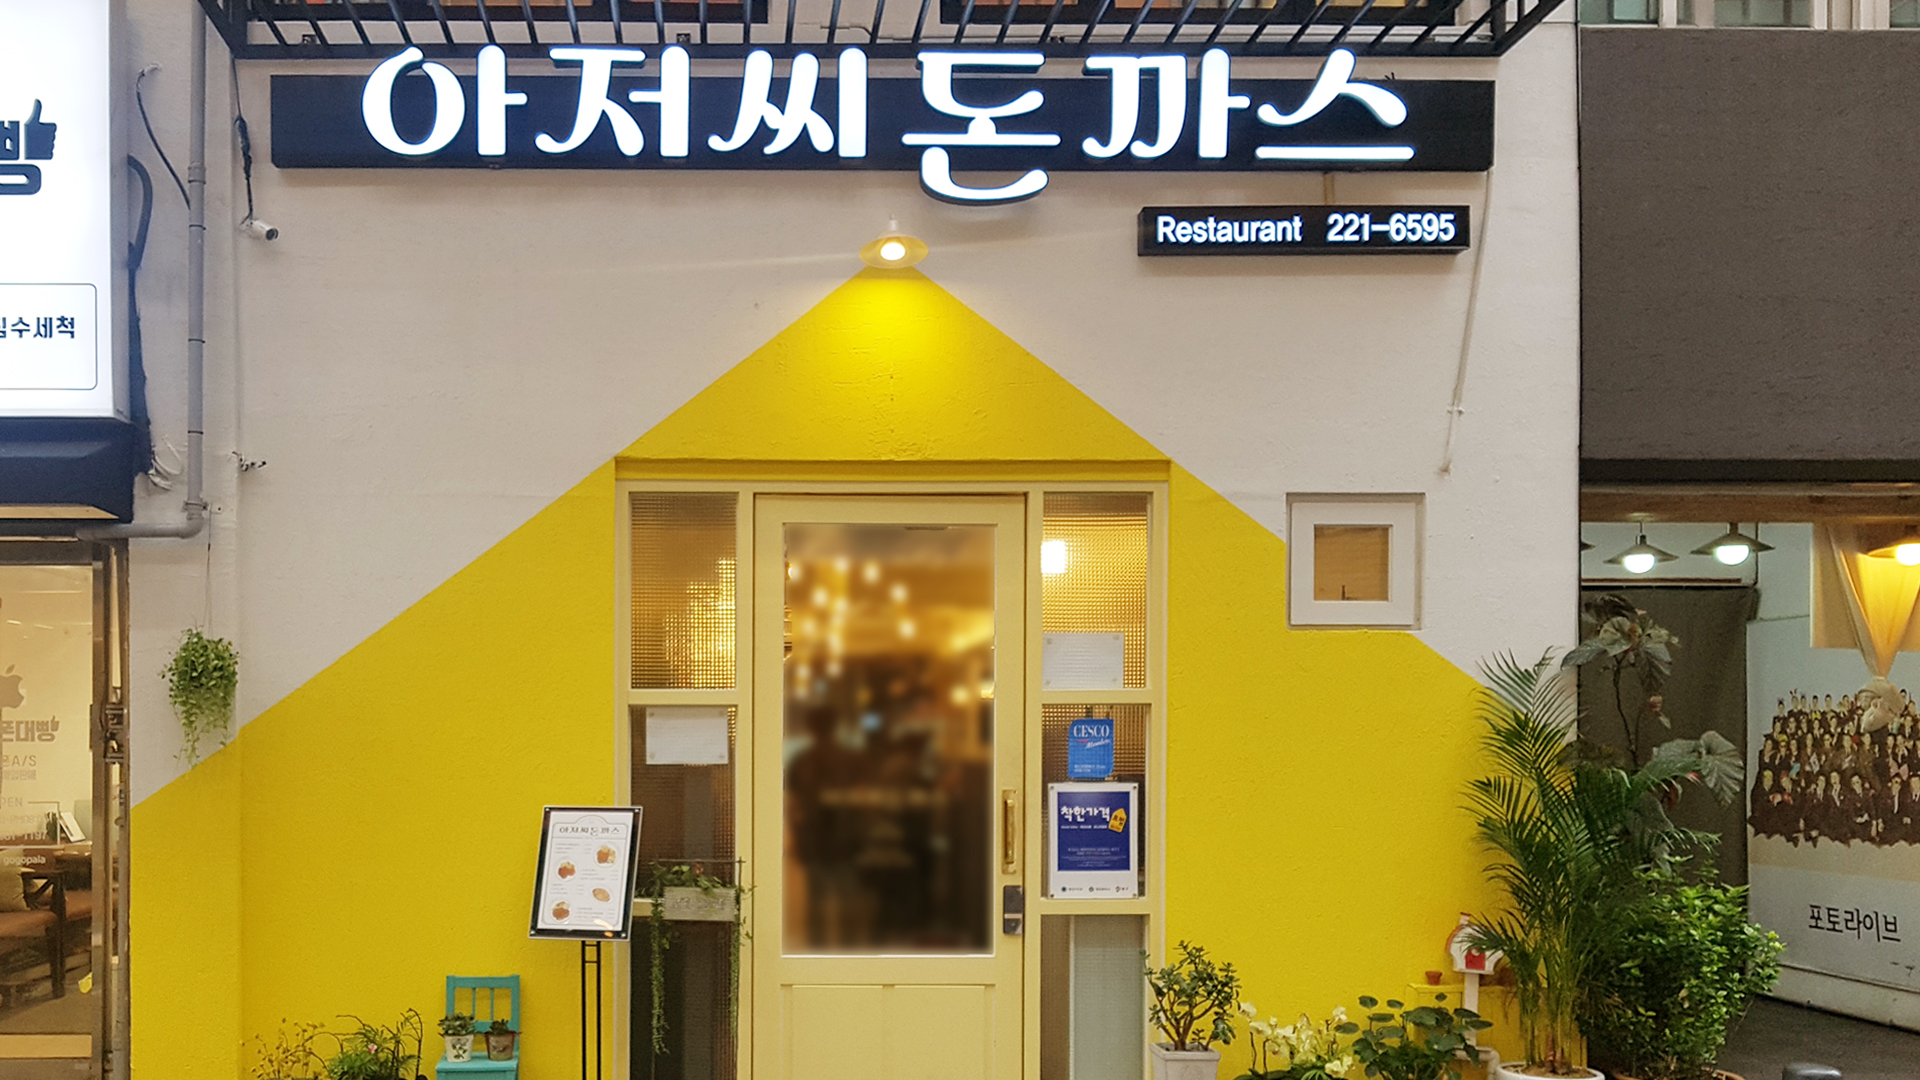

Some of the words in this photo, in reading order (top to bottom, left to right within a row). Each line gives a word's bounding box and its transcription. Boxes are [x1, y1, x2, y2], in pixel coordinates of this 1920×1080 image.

[1156, 215, 1303, 243] Restaurant
[1326, 212, 1456, 243] 221-6595
[1073, 725, 1110, 738] CESCO
[1060, 806, 1110, 822] 착한가격
[1808, 903, 1902, 943] 포토라이브
